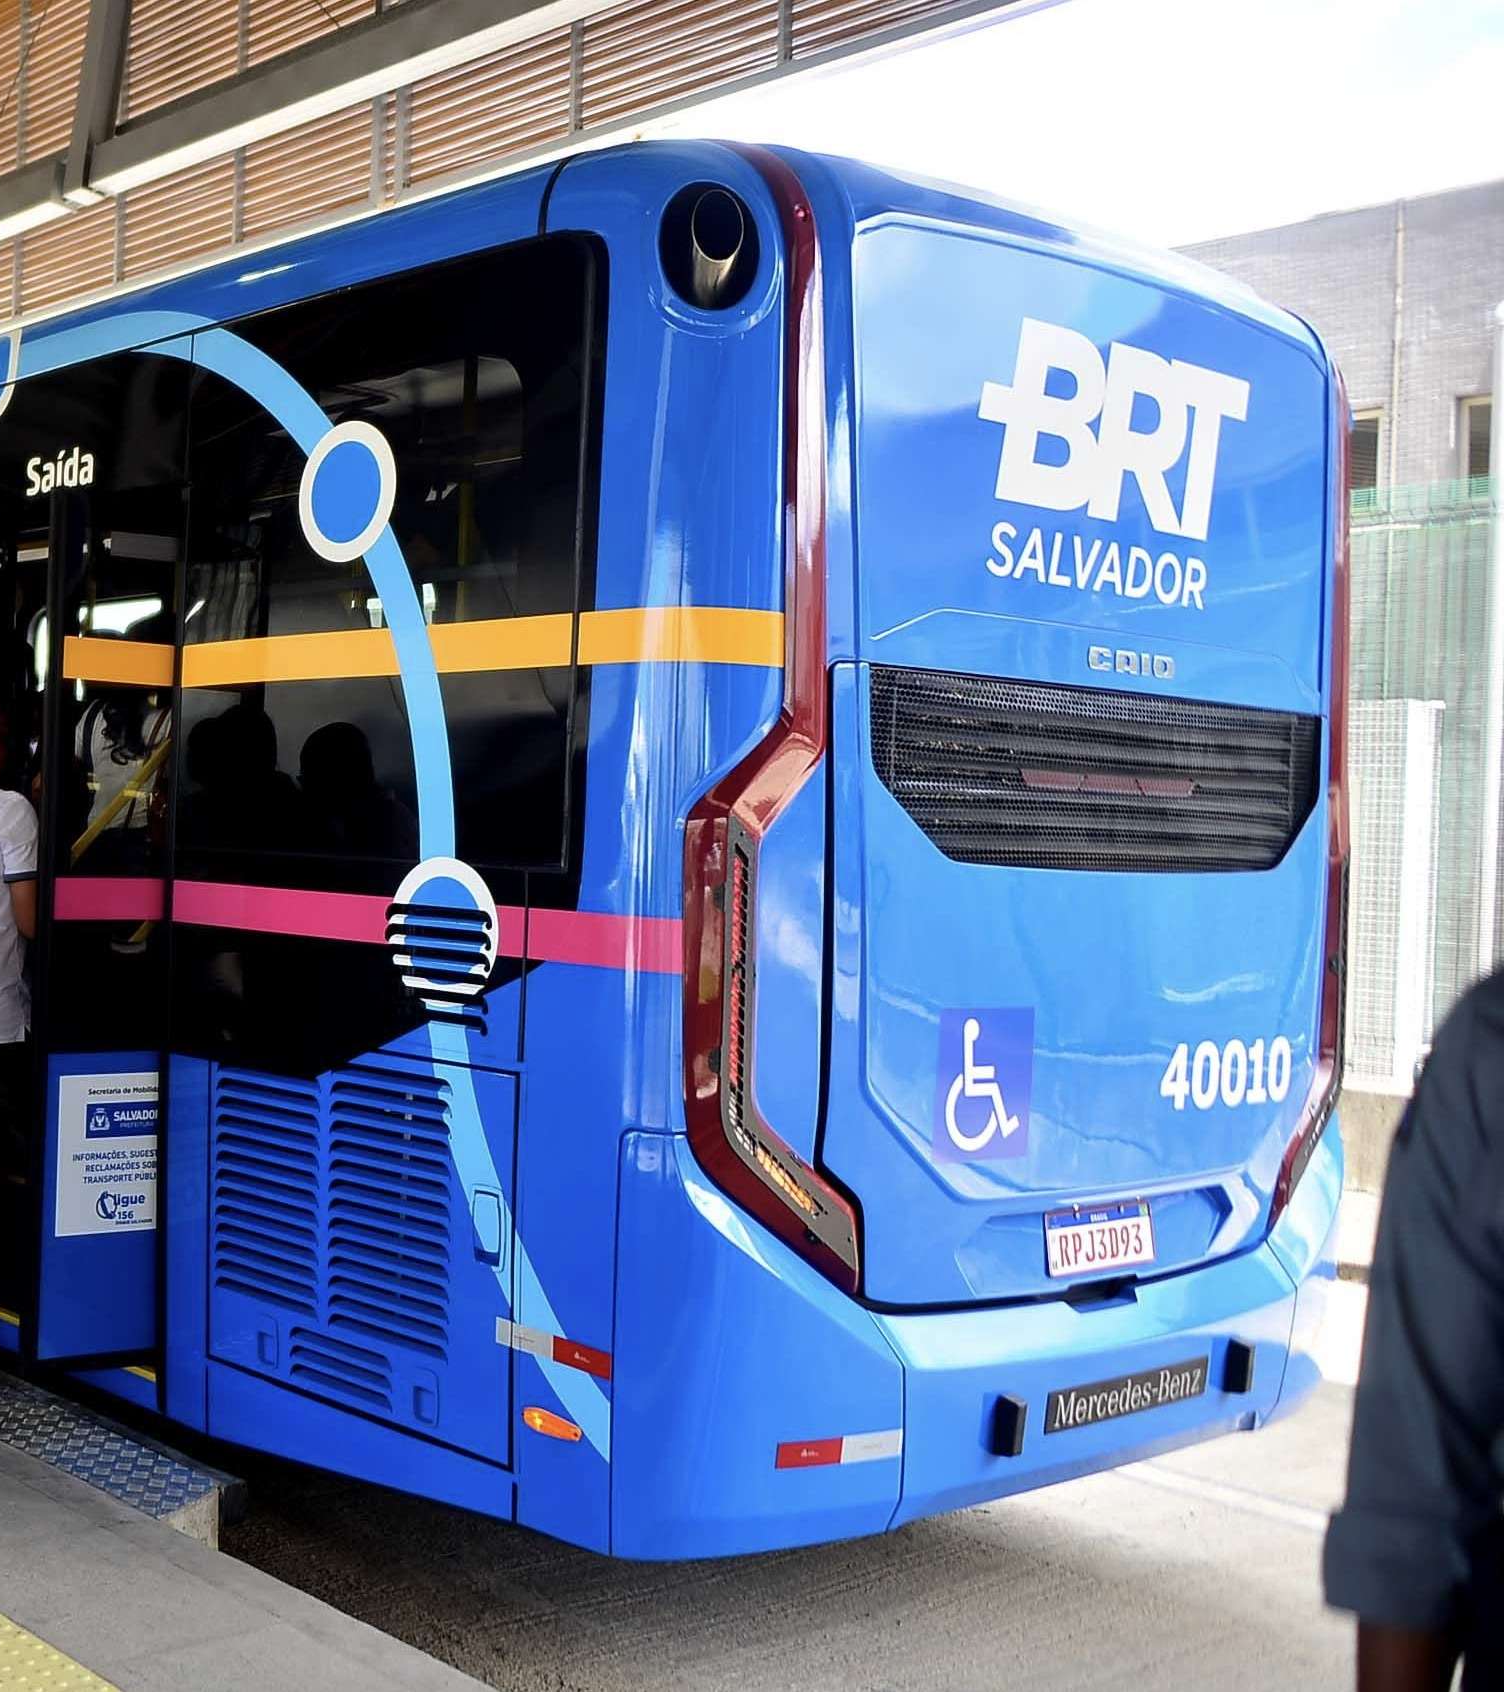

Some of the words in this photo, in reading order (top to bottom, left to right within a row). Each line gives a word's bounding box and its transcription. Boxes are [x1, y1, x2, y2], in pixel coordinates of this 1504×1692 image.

[977, 316, 1251, 542] BRT
[26, 446, 94, 497] Saída
[985, 521, 1208, 611] SALVADOR
[1087, 645, 1176, 680] CAIO
[1160, 1035, 1292, 1111] 40010
[82, 1173, 133, 1185] TRANSPORTE
[117, 1210, 134, 1220] 156
[1058, 1223, 1143, 1268] RPJ3D93
[1053, 1365, 1202, 1429] Mercedes-Benz
